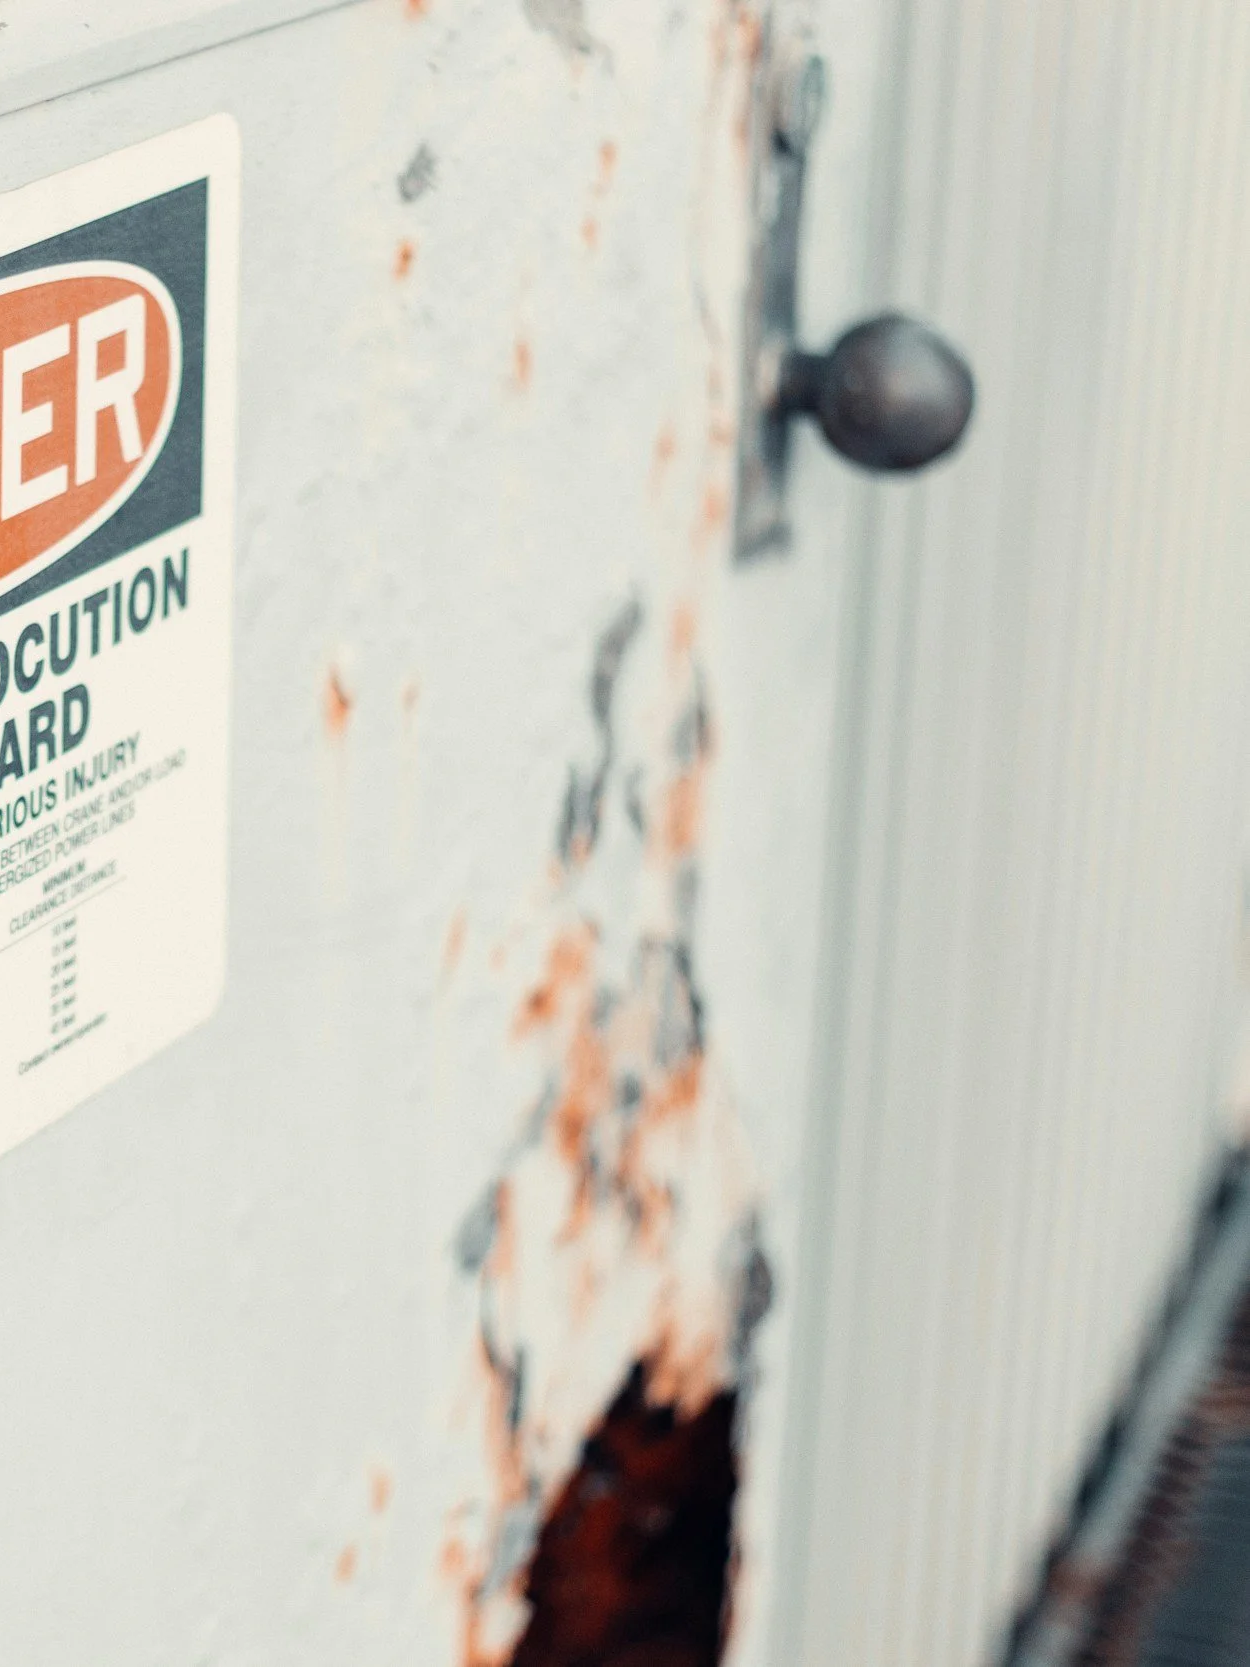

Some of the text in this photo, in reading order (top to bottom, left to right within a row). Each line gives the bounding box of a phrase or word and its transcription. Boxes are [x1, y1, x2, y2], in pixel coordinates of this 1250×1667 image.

[65, 730, 140, 800] INJURY
[0, 818, 59, 870] BETWEEN
[63, 794, 104, 832] CRANE
[55, 821, 99, 861] POWER
